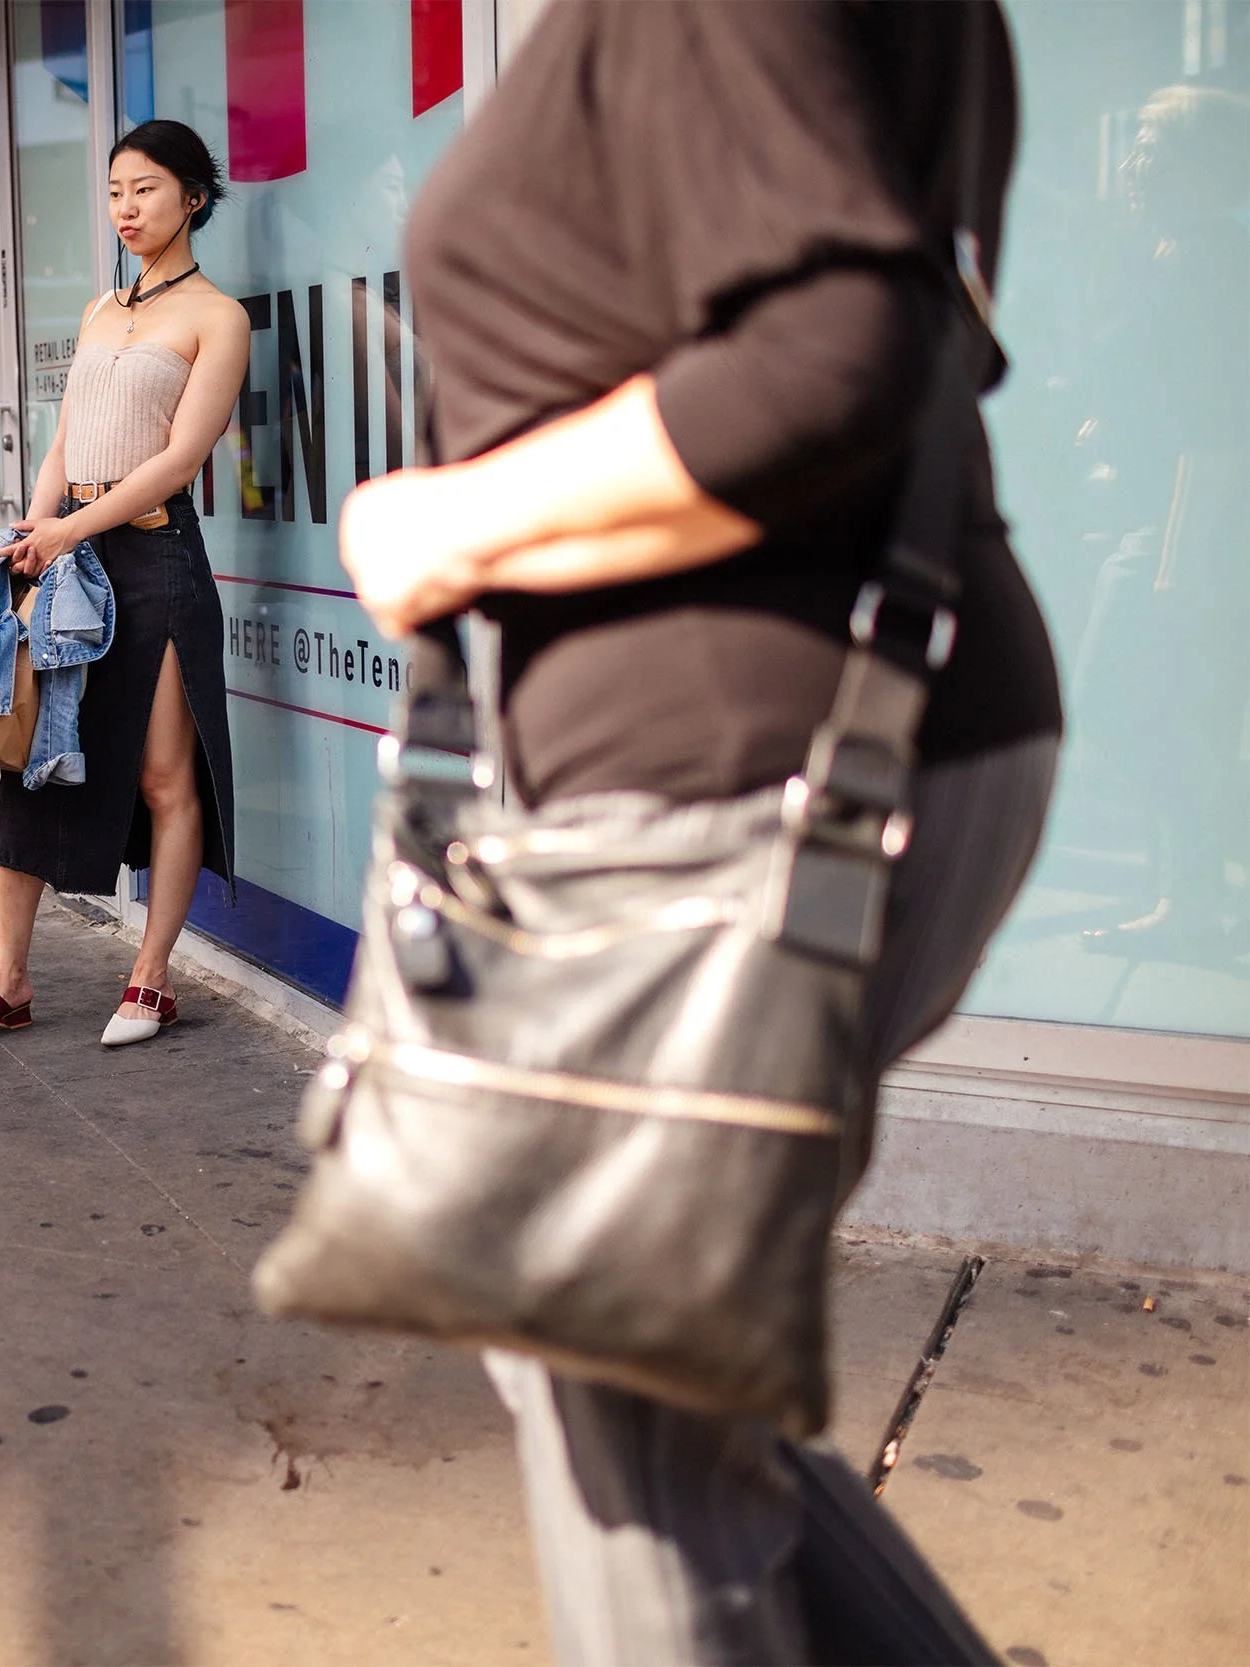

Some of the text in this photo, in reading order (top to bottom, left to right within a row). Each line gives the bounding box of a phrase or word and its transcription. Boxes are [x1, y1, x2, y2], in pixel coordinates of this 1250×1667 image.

[35, 338, 79, 363] RETAIL LEA
[230, 617, 280, 666] HERE
